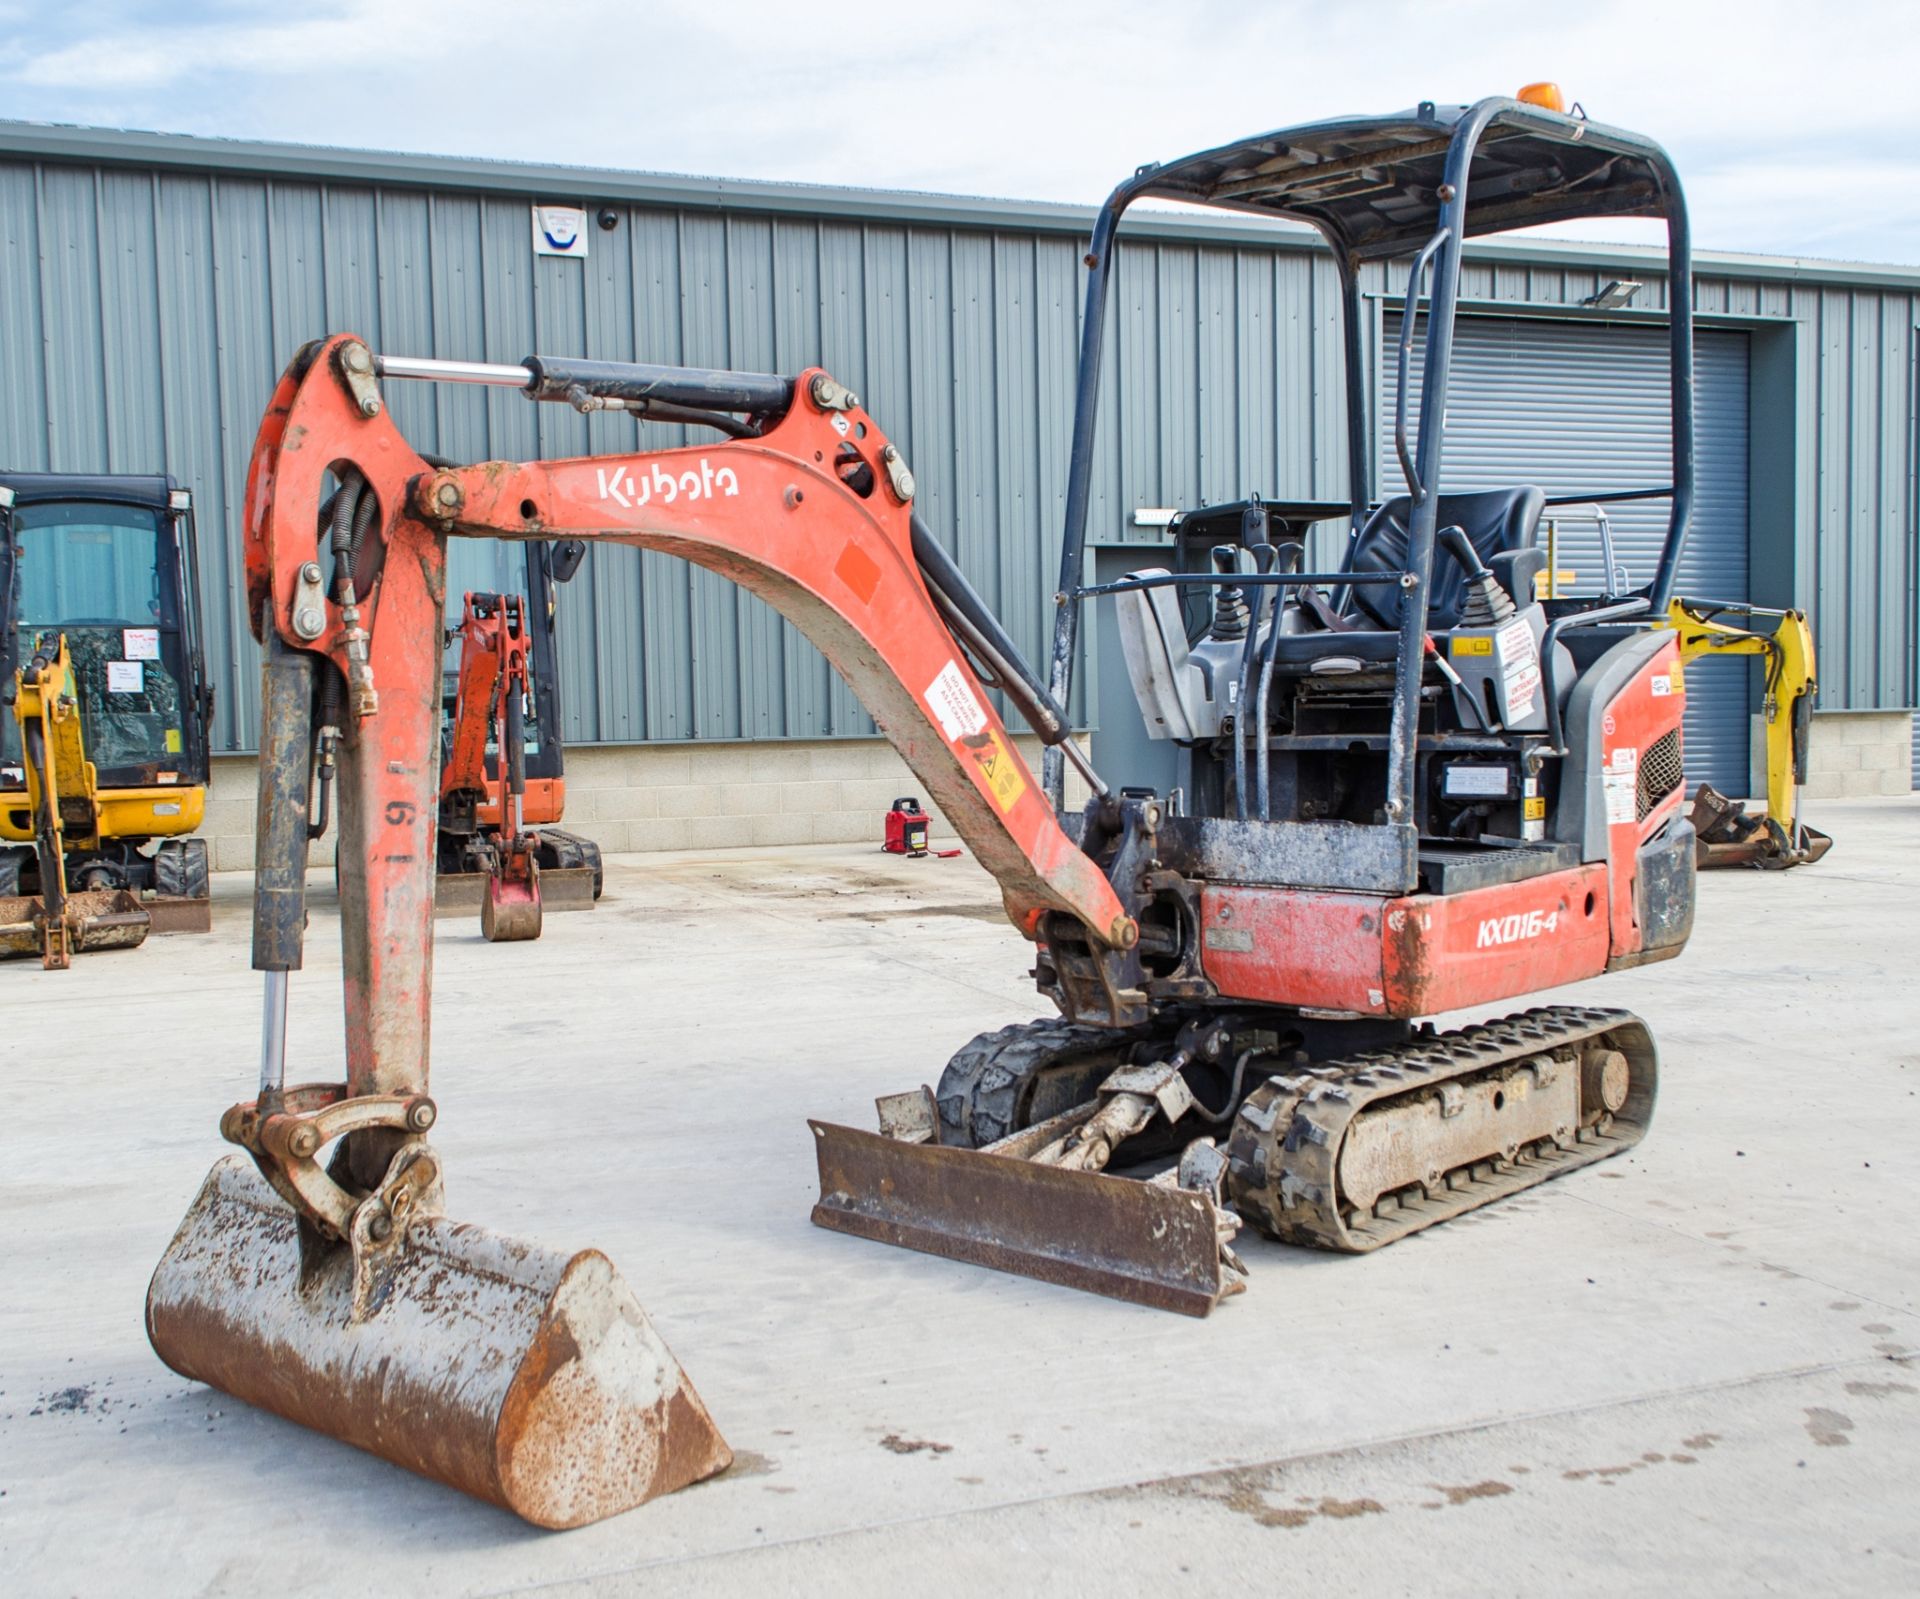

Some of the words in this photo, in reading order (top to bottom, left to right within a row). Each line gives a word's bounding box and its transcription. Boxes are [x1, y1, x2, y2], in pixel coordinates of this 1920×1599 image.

[597, 458, 739, 508] Kubota
[941, 674, 953, 691] THIS
[950, 674, 960, 687] DO
[958, 687, 969, 703] NOT
[967, 703, 977, 718] USE
[1477, 910, 1557, 949] KX016-4
